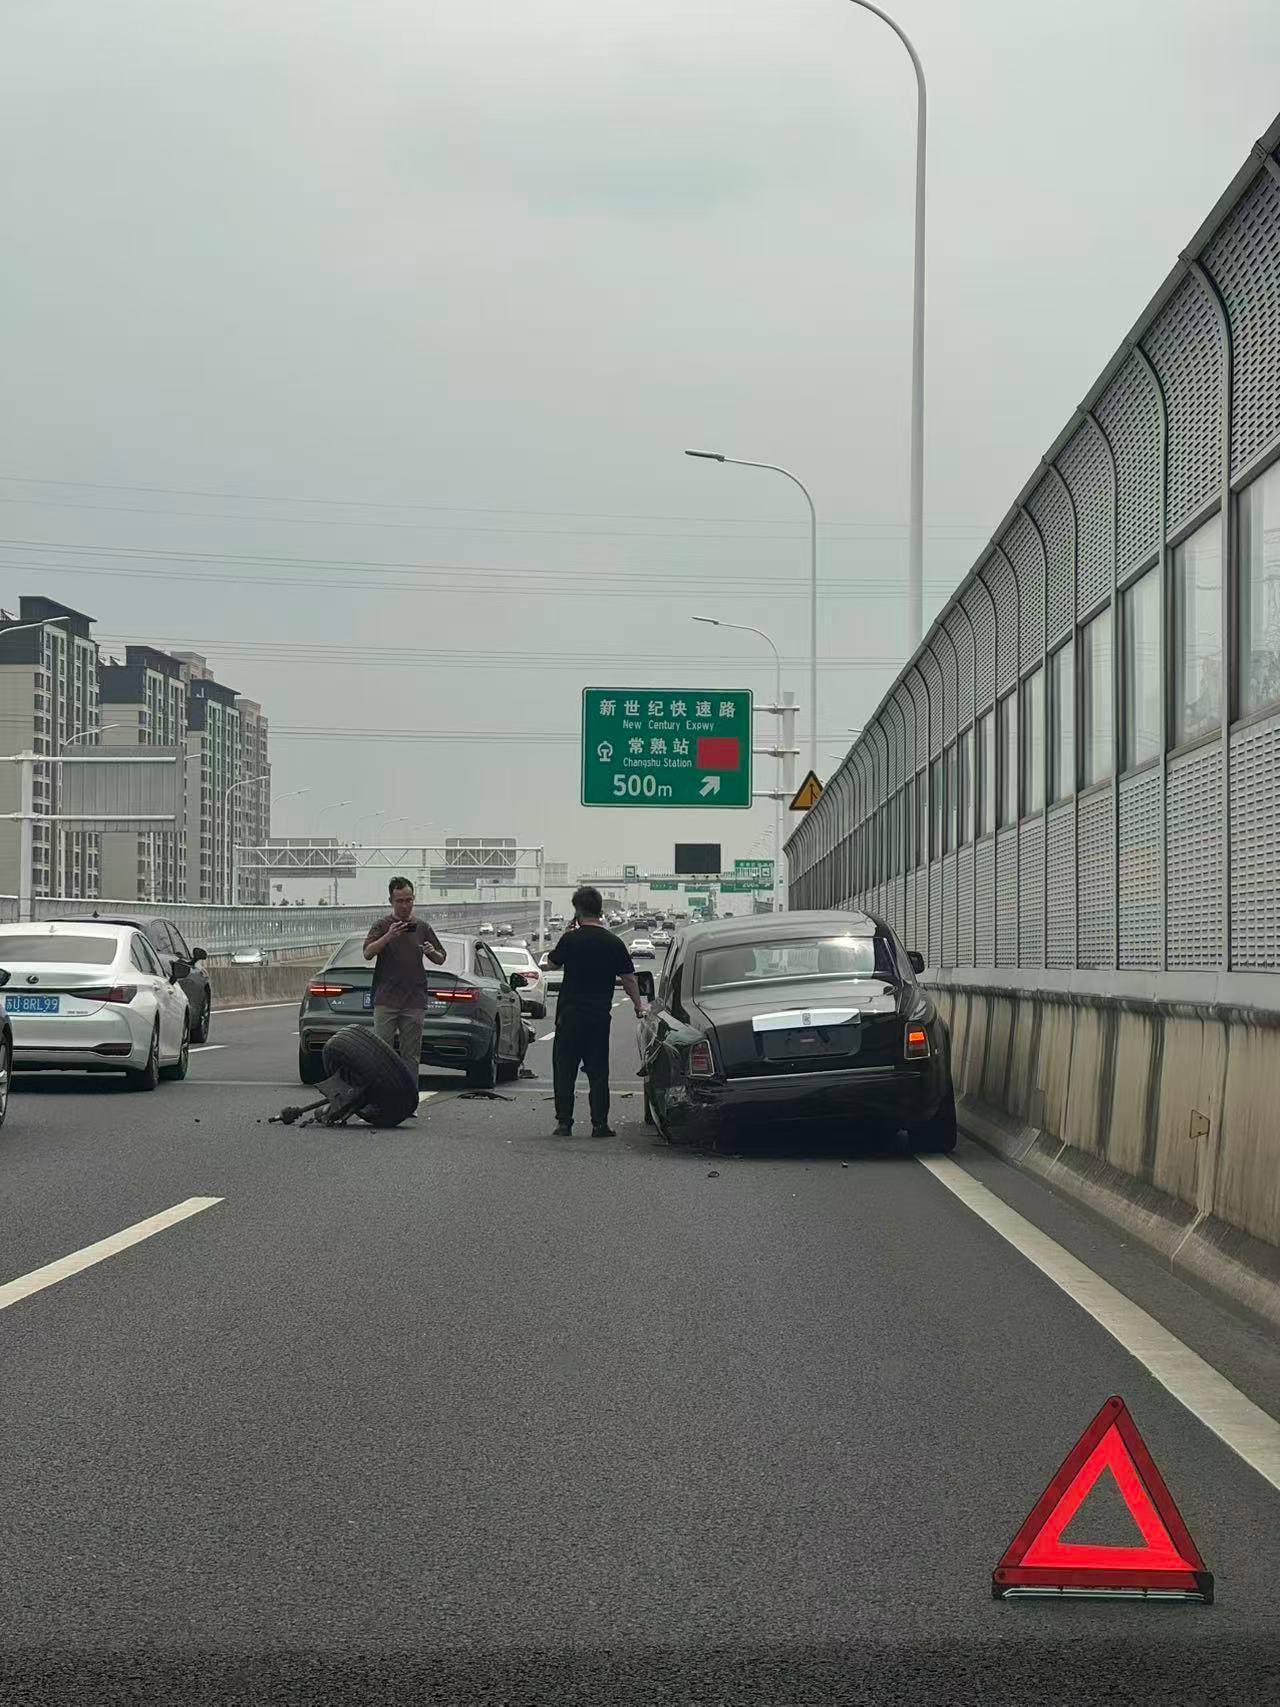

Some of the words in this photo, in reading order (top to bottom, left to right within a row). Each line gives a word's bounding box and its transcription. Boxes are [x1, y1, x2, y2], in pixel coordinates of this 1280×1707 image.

[600, 699, 736, 717] 新世纪快速路
[622, 719, 642, 730] New
[648, 720, 681, 731] Century
[686, 720, 715, 732] Expwy
[628, 737, 690, 755] 常熟站
[623, 757, 661, 768] Changshu
[663, 758, 693, 768] Station
[613, 774, 672, 797] 500m
